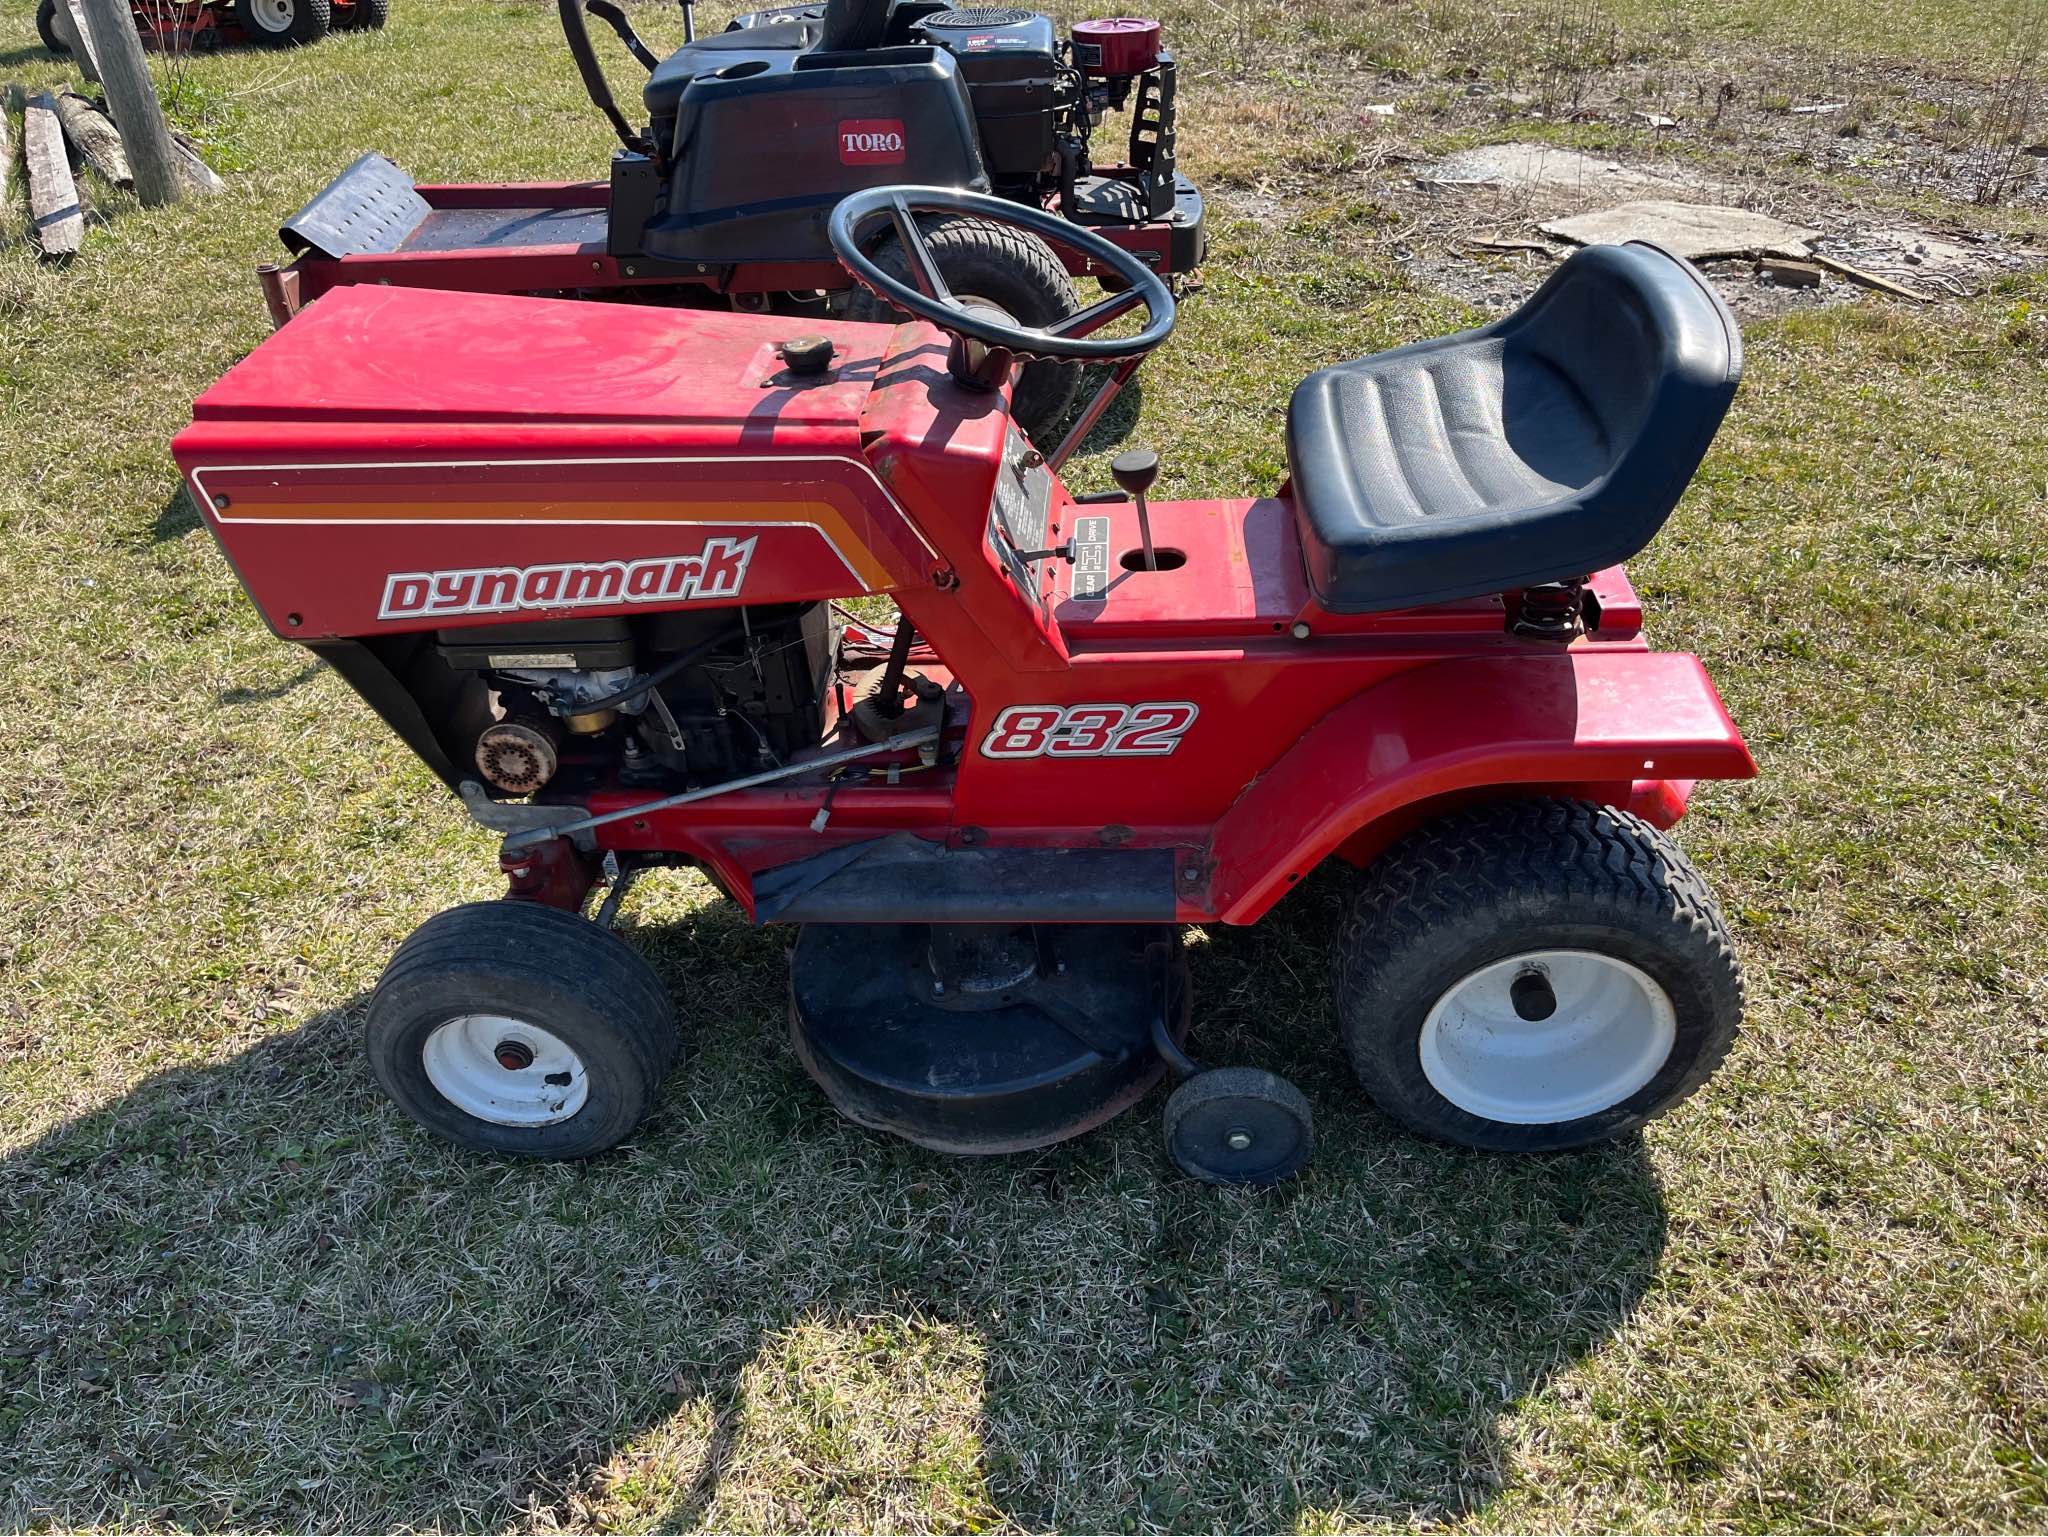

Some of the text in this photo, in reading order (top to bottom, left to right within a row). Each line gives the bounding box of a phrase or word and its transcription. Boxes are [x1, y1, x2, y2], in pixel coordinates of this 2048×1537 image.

[842, 133, 901, 151] TORO
[1088, 519, 1097, 542] DRIVE
[980, 701, 1199, 758] 832
